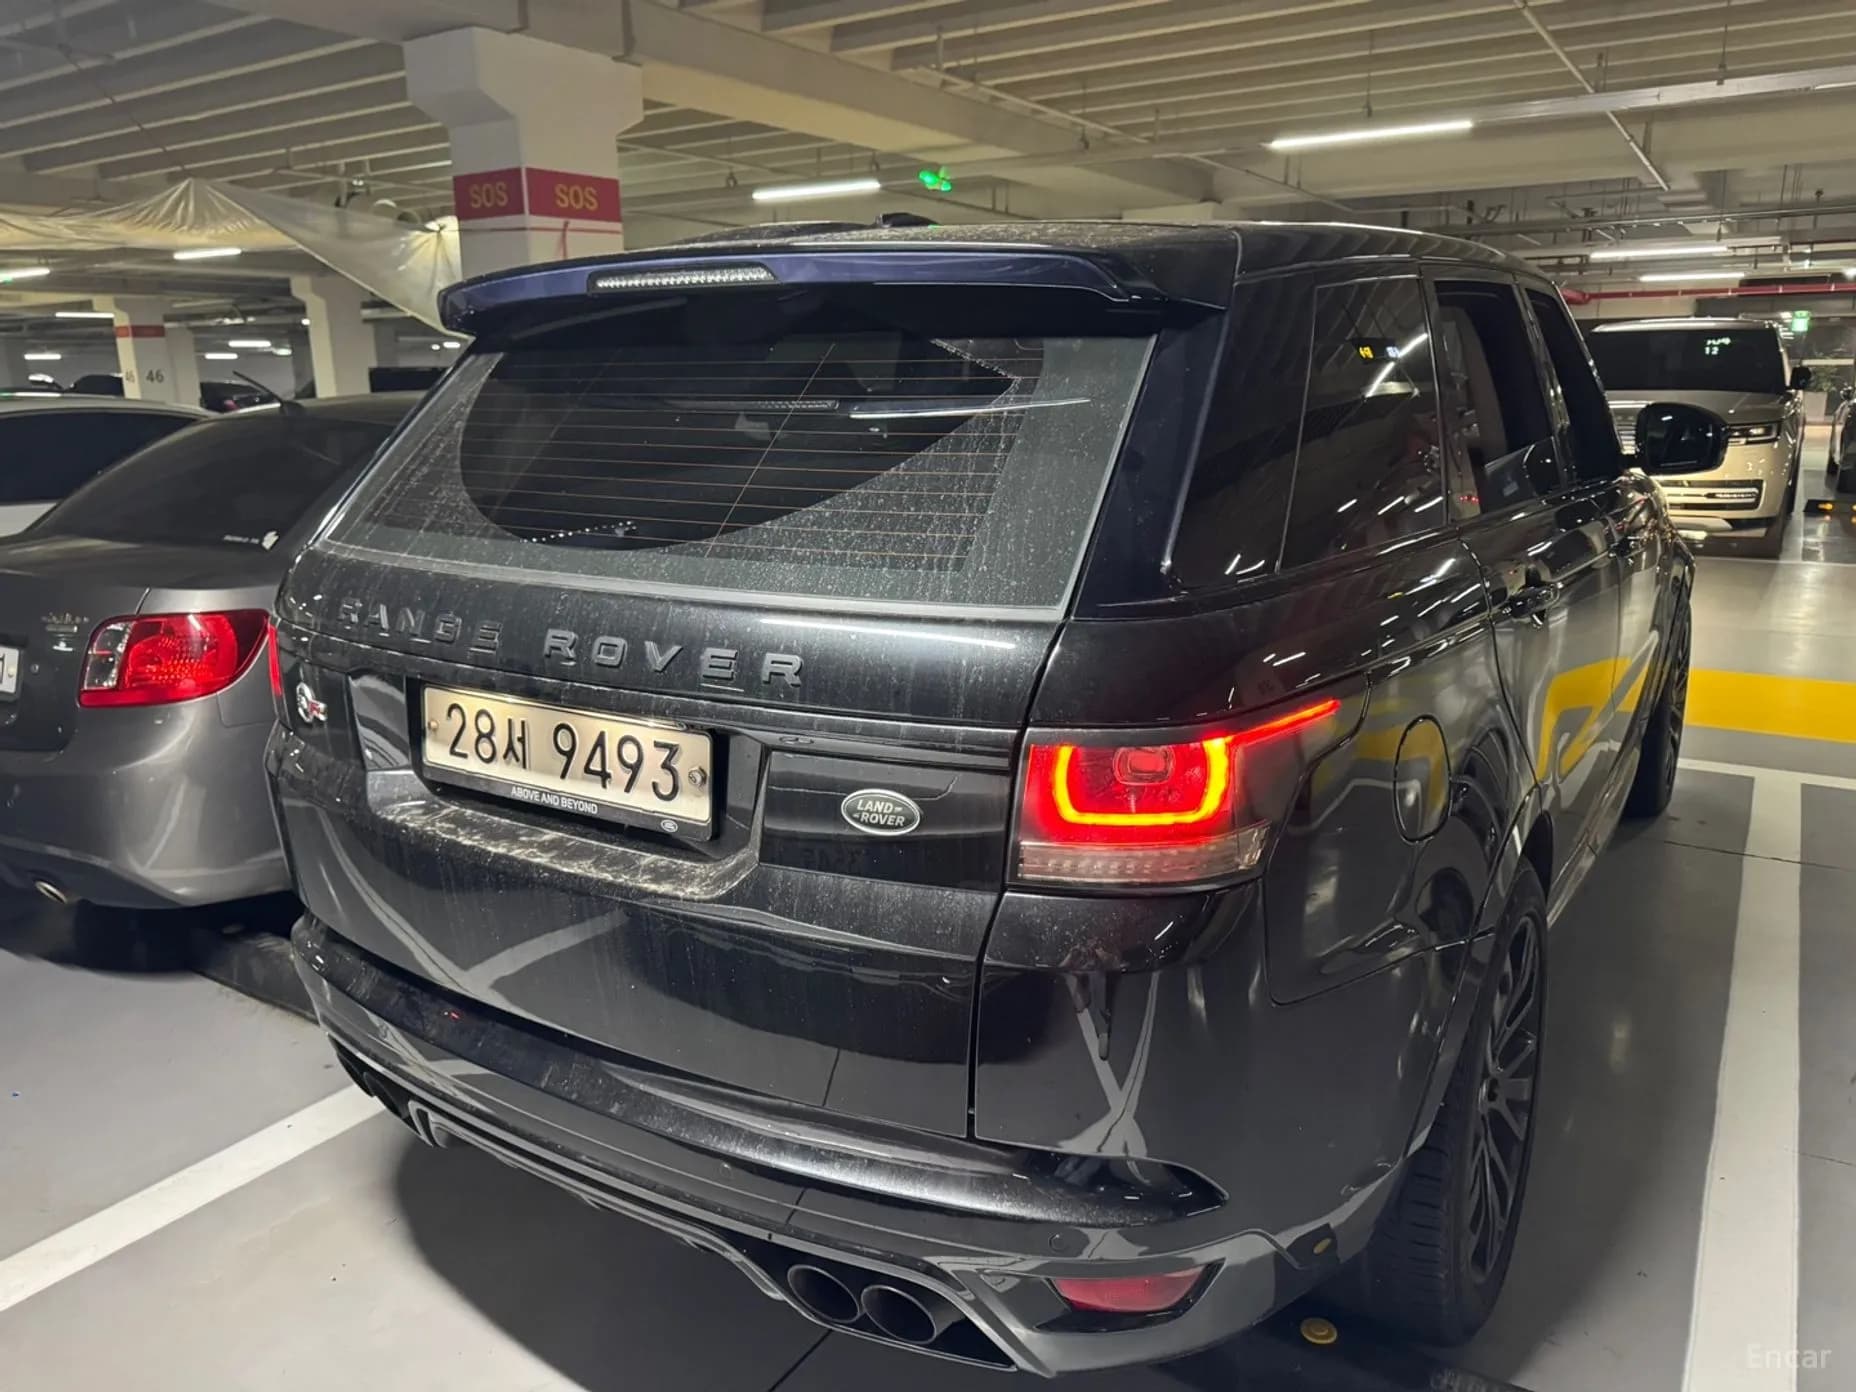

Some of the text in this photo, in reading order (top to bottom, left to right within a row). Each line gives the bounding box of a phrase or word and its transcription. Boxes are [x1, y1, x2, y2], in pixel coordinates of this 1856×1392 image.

[469, 181, 509, 209] SOS
[554, 183, 599, 211] SOS
[145, 369, 165, 384] 46
[338, 597, 804, 688] RANGE ROVER
[446, 702, 681, 803] 28서 9493
[511, 785, 598, 815] ABOVE AND BEYOND
[856, 799, 893, 813] LAND
[860, 812, 905, 827] ROVER
